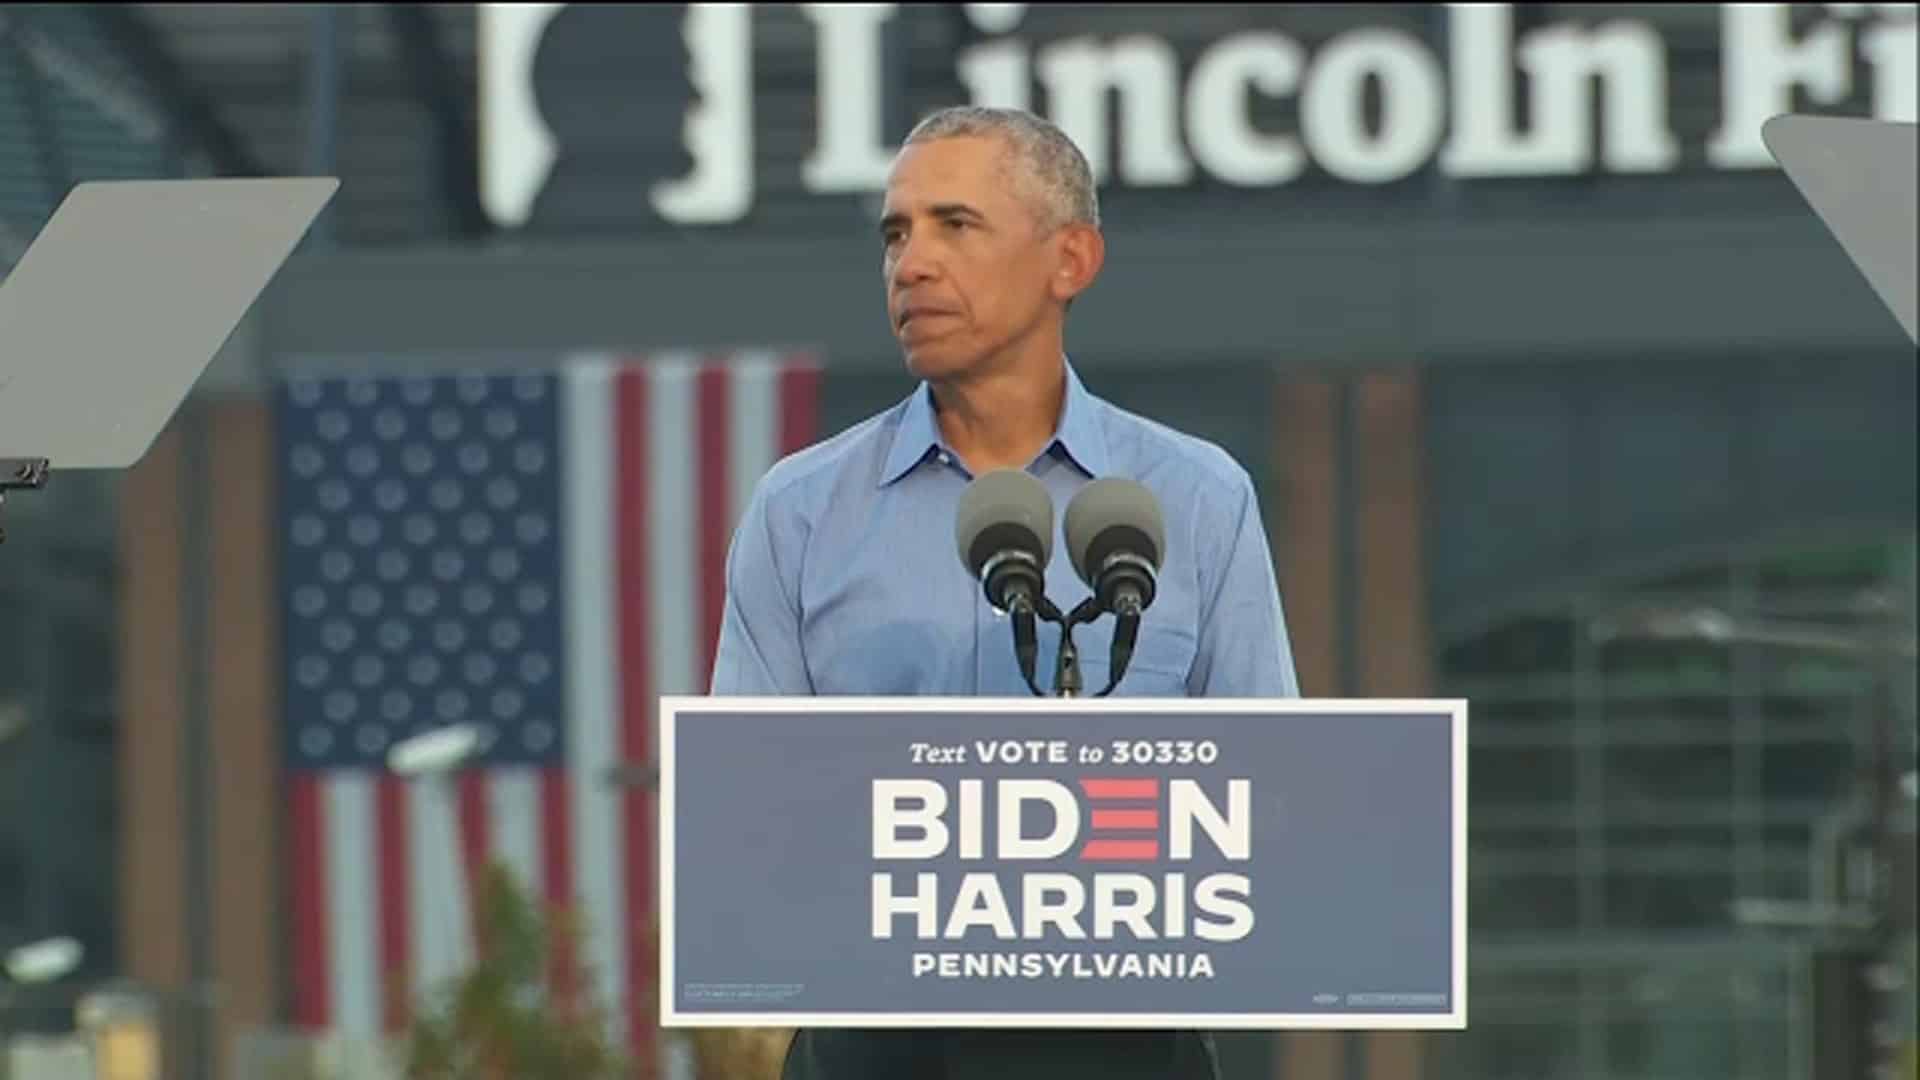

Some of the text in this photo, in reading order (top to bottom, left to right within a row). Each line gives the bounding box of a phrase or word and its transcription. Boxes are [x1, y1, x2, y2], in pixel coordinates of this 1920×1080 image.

[801, 3, 1676, 191] Lincoln
[909, 741, 1219, 764] Text VOTE to 30330
[871, 778, 1251, 860] BIDEN
[871, 872, 1255, 942] HARRIS
[913, 952, 1215, 978] PENNSYLVANIA
